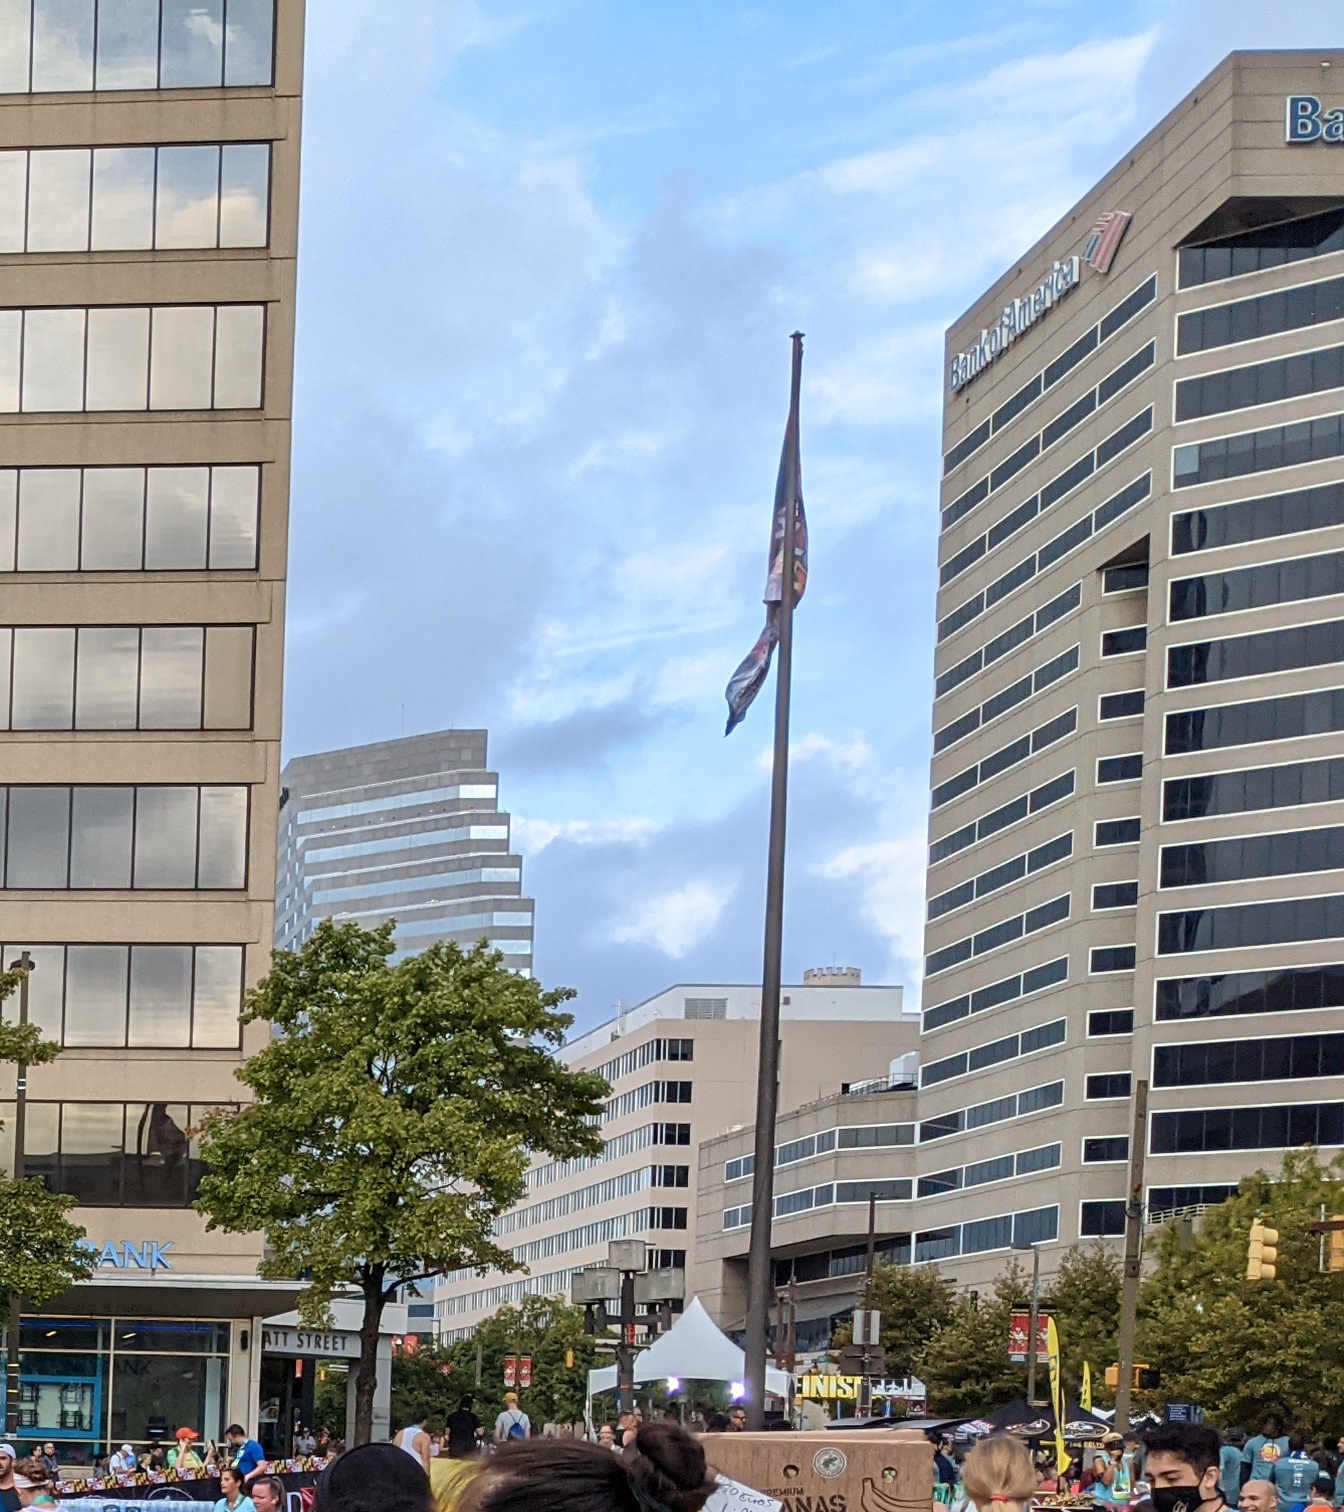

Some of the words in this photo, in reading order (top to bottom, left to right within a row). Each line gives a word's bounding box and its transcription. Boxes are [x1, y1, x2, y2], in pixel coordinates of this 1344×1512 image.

[950, 330, 993, 393] Bank
[1008, 256, 1080, 337] America
[296, 1333, 348, 1350] STREET
